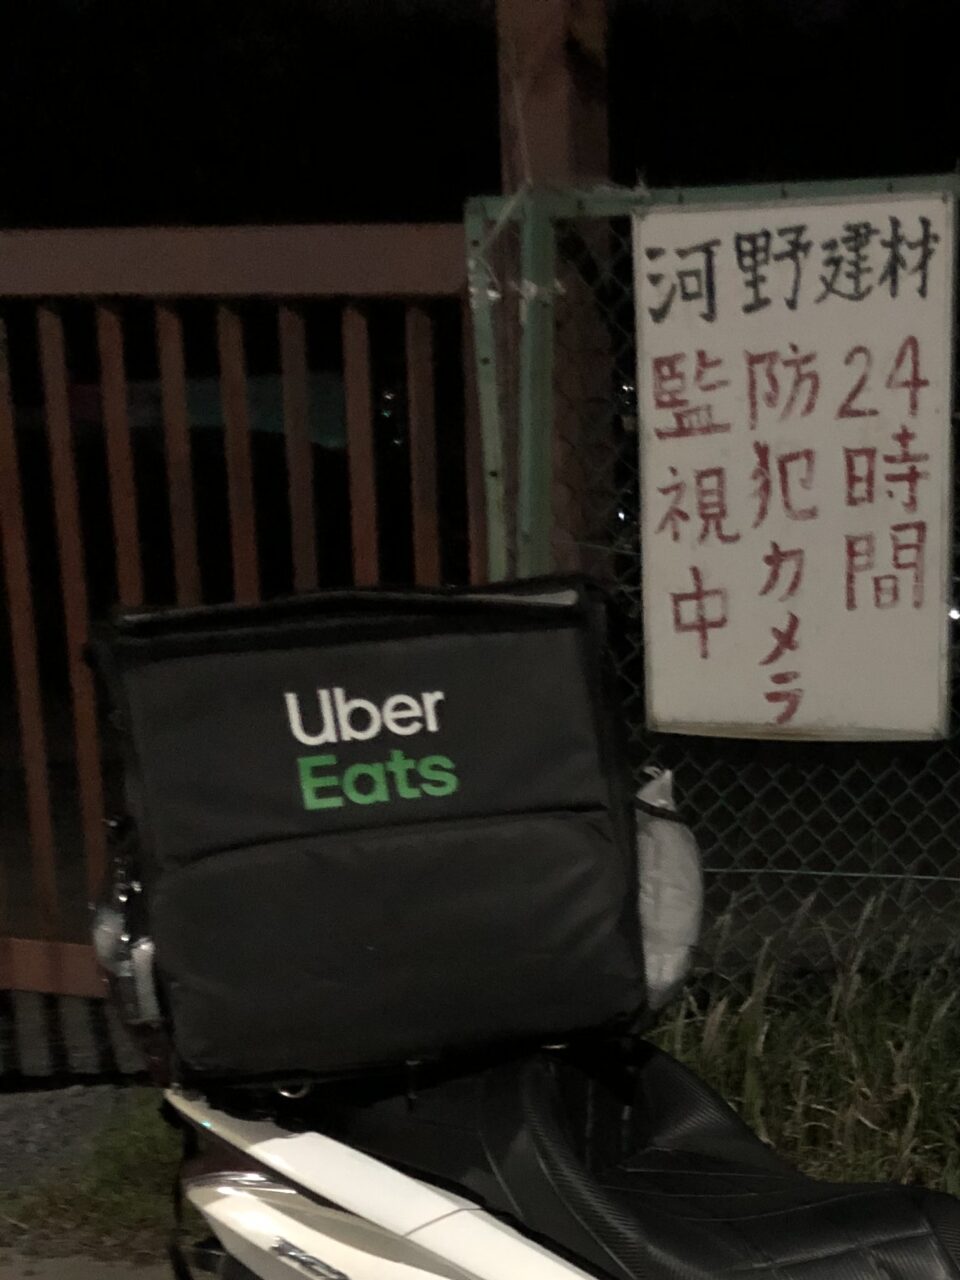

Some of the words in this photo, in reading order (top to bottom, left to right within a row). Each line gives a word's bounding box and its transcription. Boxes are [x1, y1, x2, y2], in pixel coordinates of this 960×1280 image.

[645, 217, 939, 323] 河野建材
[652, 350, 741, 659] 監視中
[745, 344, 821, 725] 防犯カメラ
[284, 687, 445, 746] Uber
[297, 749, 460, 811] Eats
